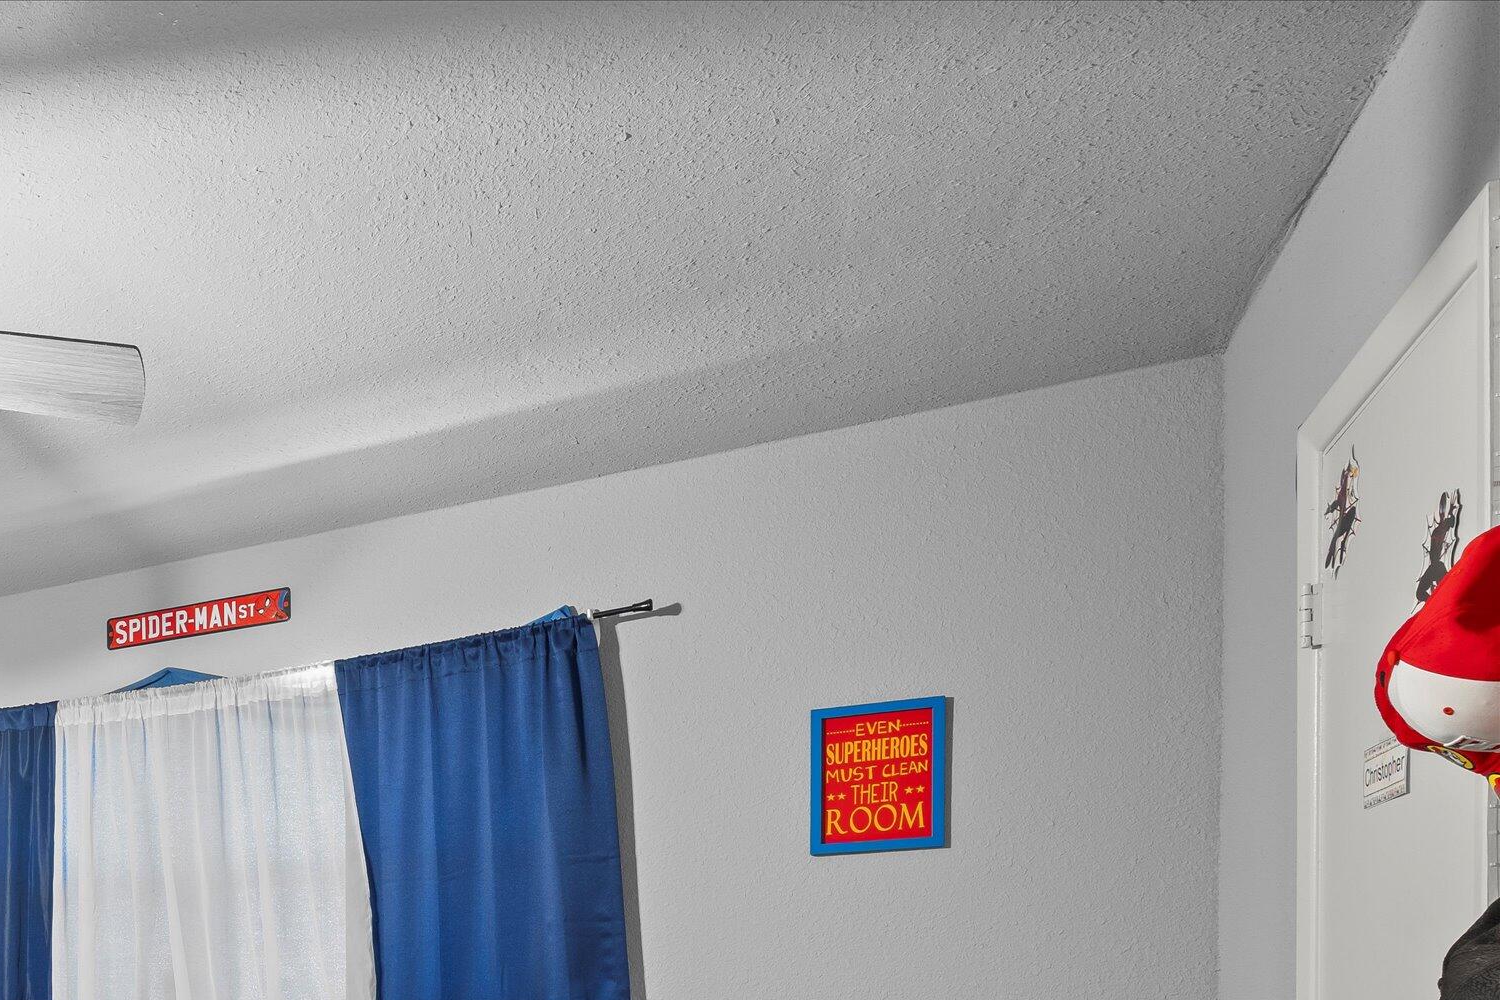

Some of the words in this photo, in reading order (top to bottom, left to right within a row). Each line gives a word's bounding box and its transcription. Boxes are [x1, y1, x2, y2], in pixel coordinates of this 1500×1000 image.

[115, 601, 237, 644] SPIDER-MAN
[238, 603, 255, 619] ST
[855, 719, 901, 737] EVEN
[826, 733, 928, 766] SUPERHEROES
[826, 767, 877, 783] MUST
[882, 760, 928, 778] CLEAN
[851, 781, 899, 805] THEIR
[825, 801, 925, 836] ROOM
